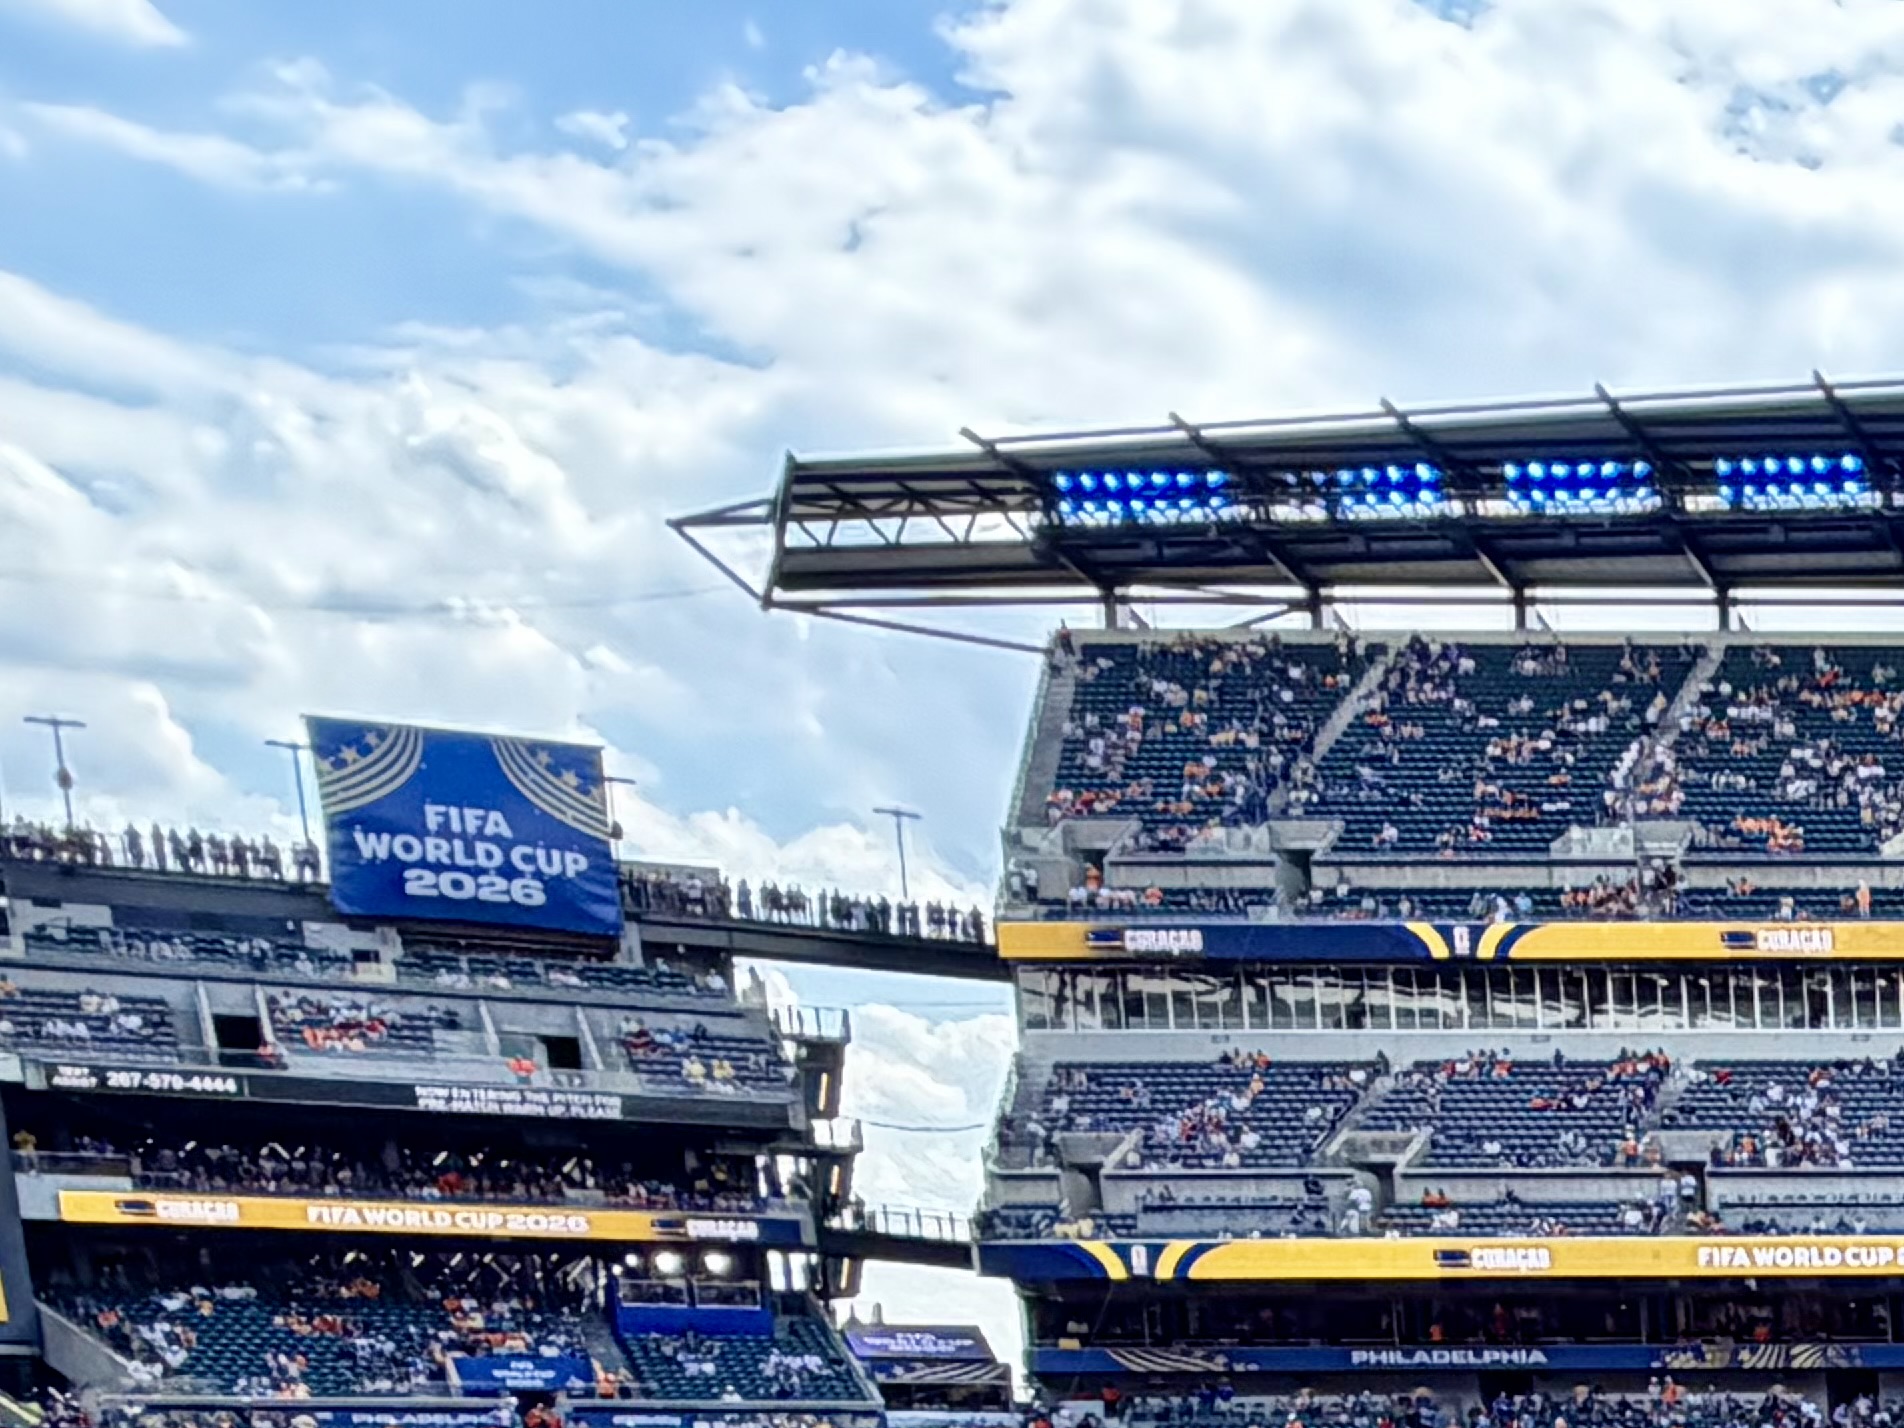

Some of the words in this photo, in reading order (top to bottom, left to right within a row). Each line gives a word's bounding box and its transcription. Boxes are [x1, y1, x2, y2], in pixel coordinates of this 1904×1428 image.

[424, 804, 514, 839] FIFA
[353, 831, 505, 869] WORLD
[510, 845, 589, 878] CUP
[403, 868, 548, 907] 2026
[306, 1204, 358, 1226] FIFA
[360, 1206, 455, 1229] WORLD
[455, 1210, 507, 1231] CUP
[507, 1212, 590, 1234] 2026
[1697, 1245, 1752, 1268] FIFA
[1750, 1245, 1841, 1268] WORLD
[1843, 1245, 1895, 1268] CUP
[1352, 1349, 1549, 1366] PHILADELPHIA
